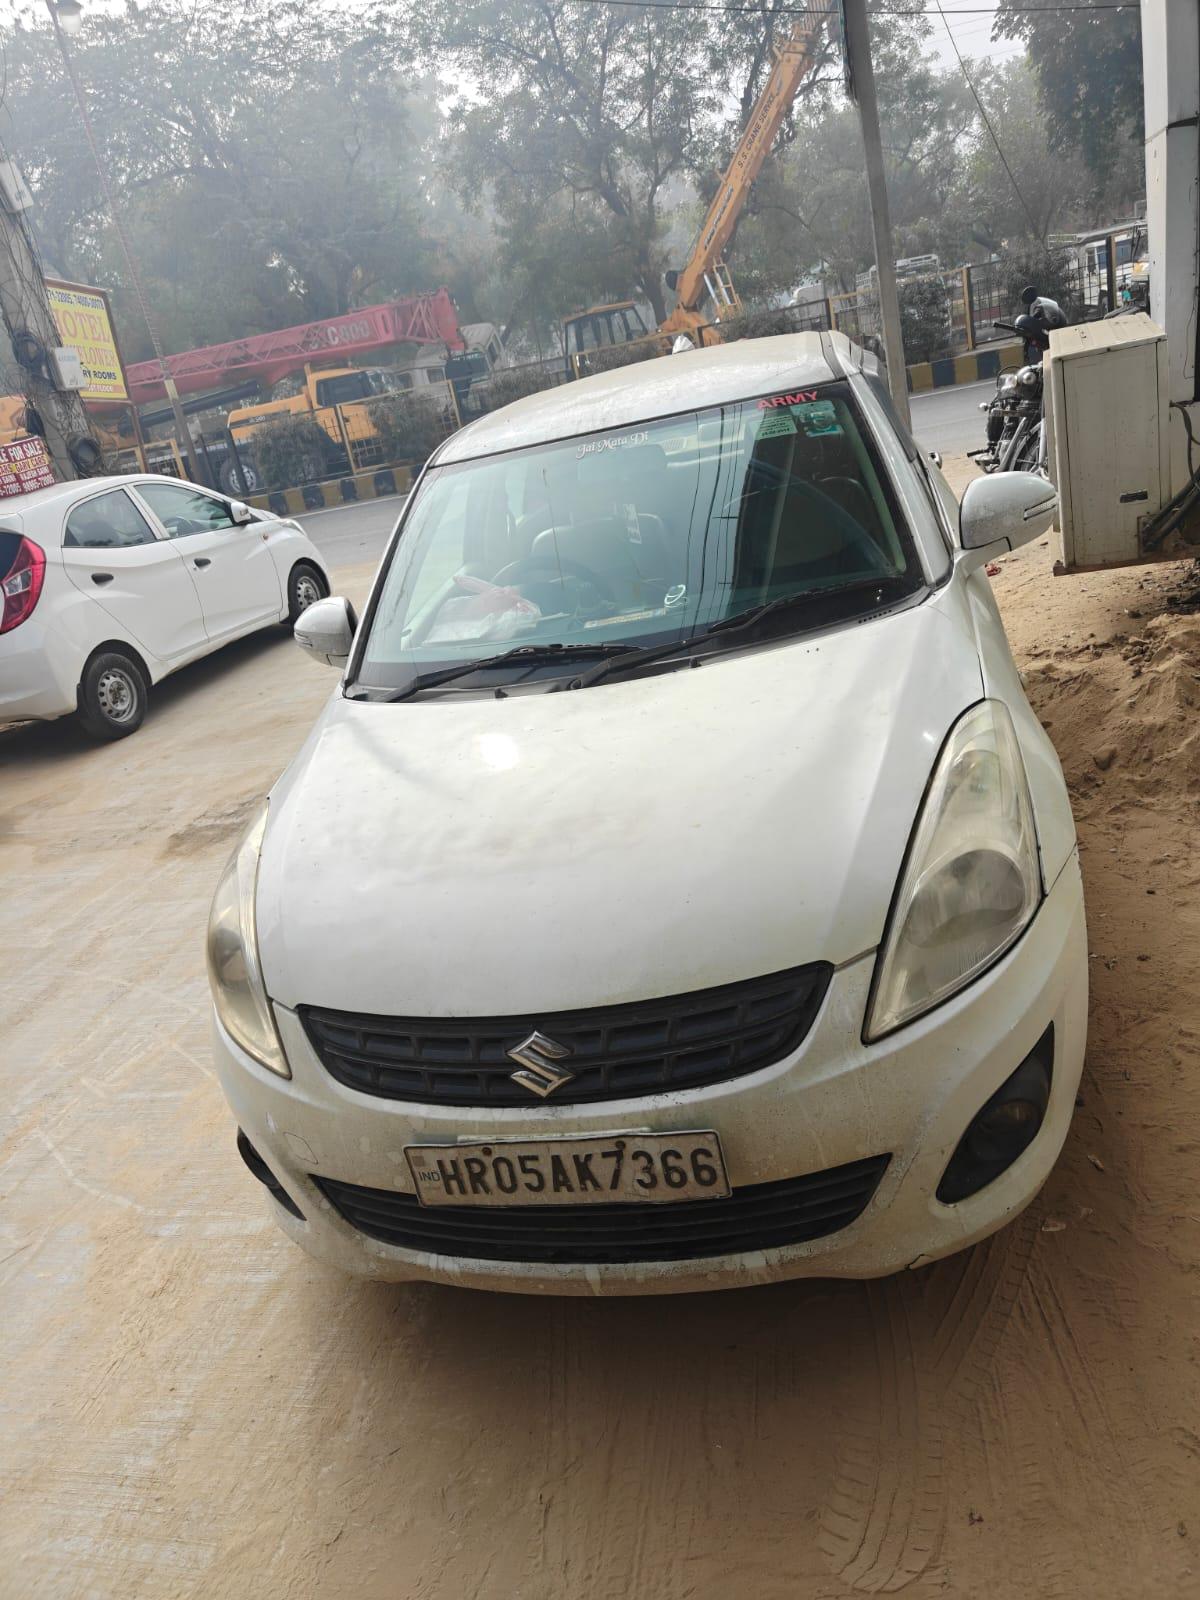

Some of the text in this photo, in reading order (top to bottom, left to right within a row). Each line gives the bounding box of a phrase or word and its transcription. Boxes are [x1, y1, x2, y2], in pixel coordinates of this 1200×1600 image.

[745, 122, 761, 151] CRANE
[93, 371, 117, 380] ROOMS
[758, 391, 817, 410] ARMY
[8, 446, 26, 462] FOR
[22, 440, 43, 458] SALE
[576, 431, 648, 459] Jai Mata Di
[418, 1148, 718, 1196] IND HR05AK7366
